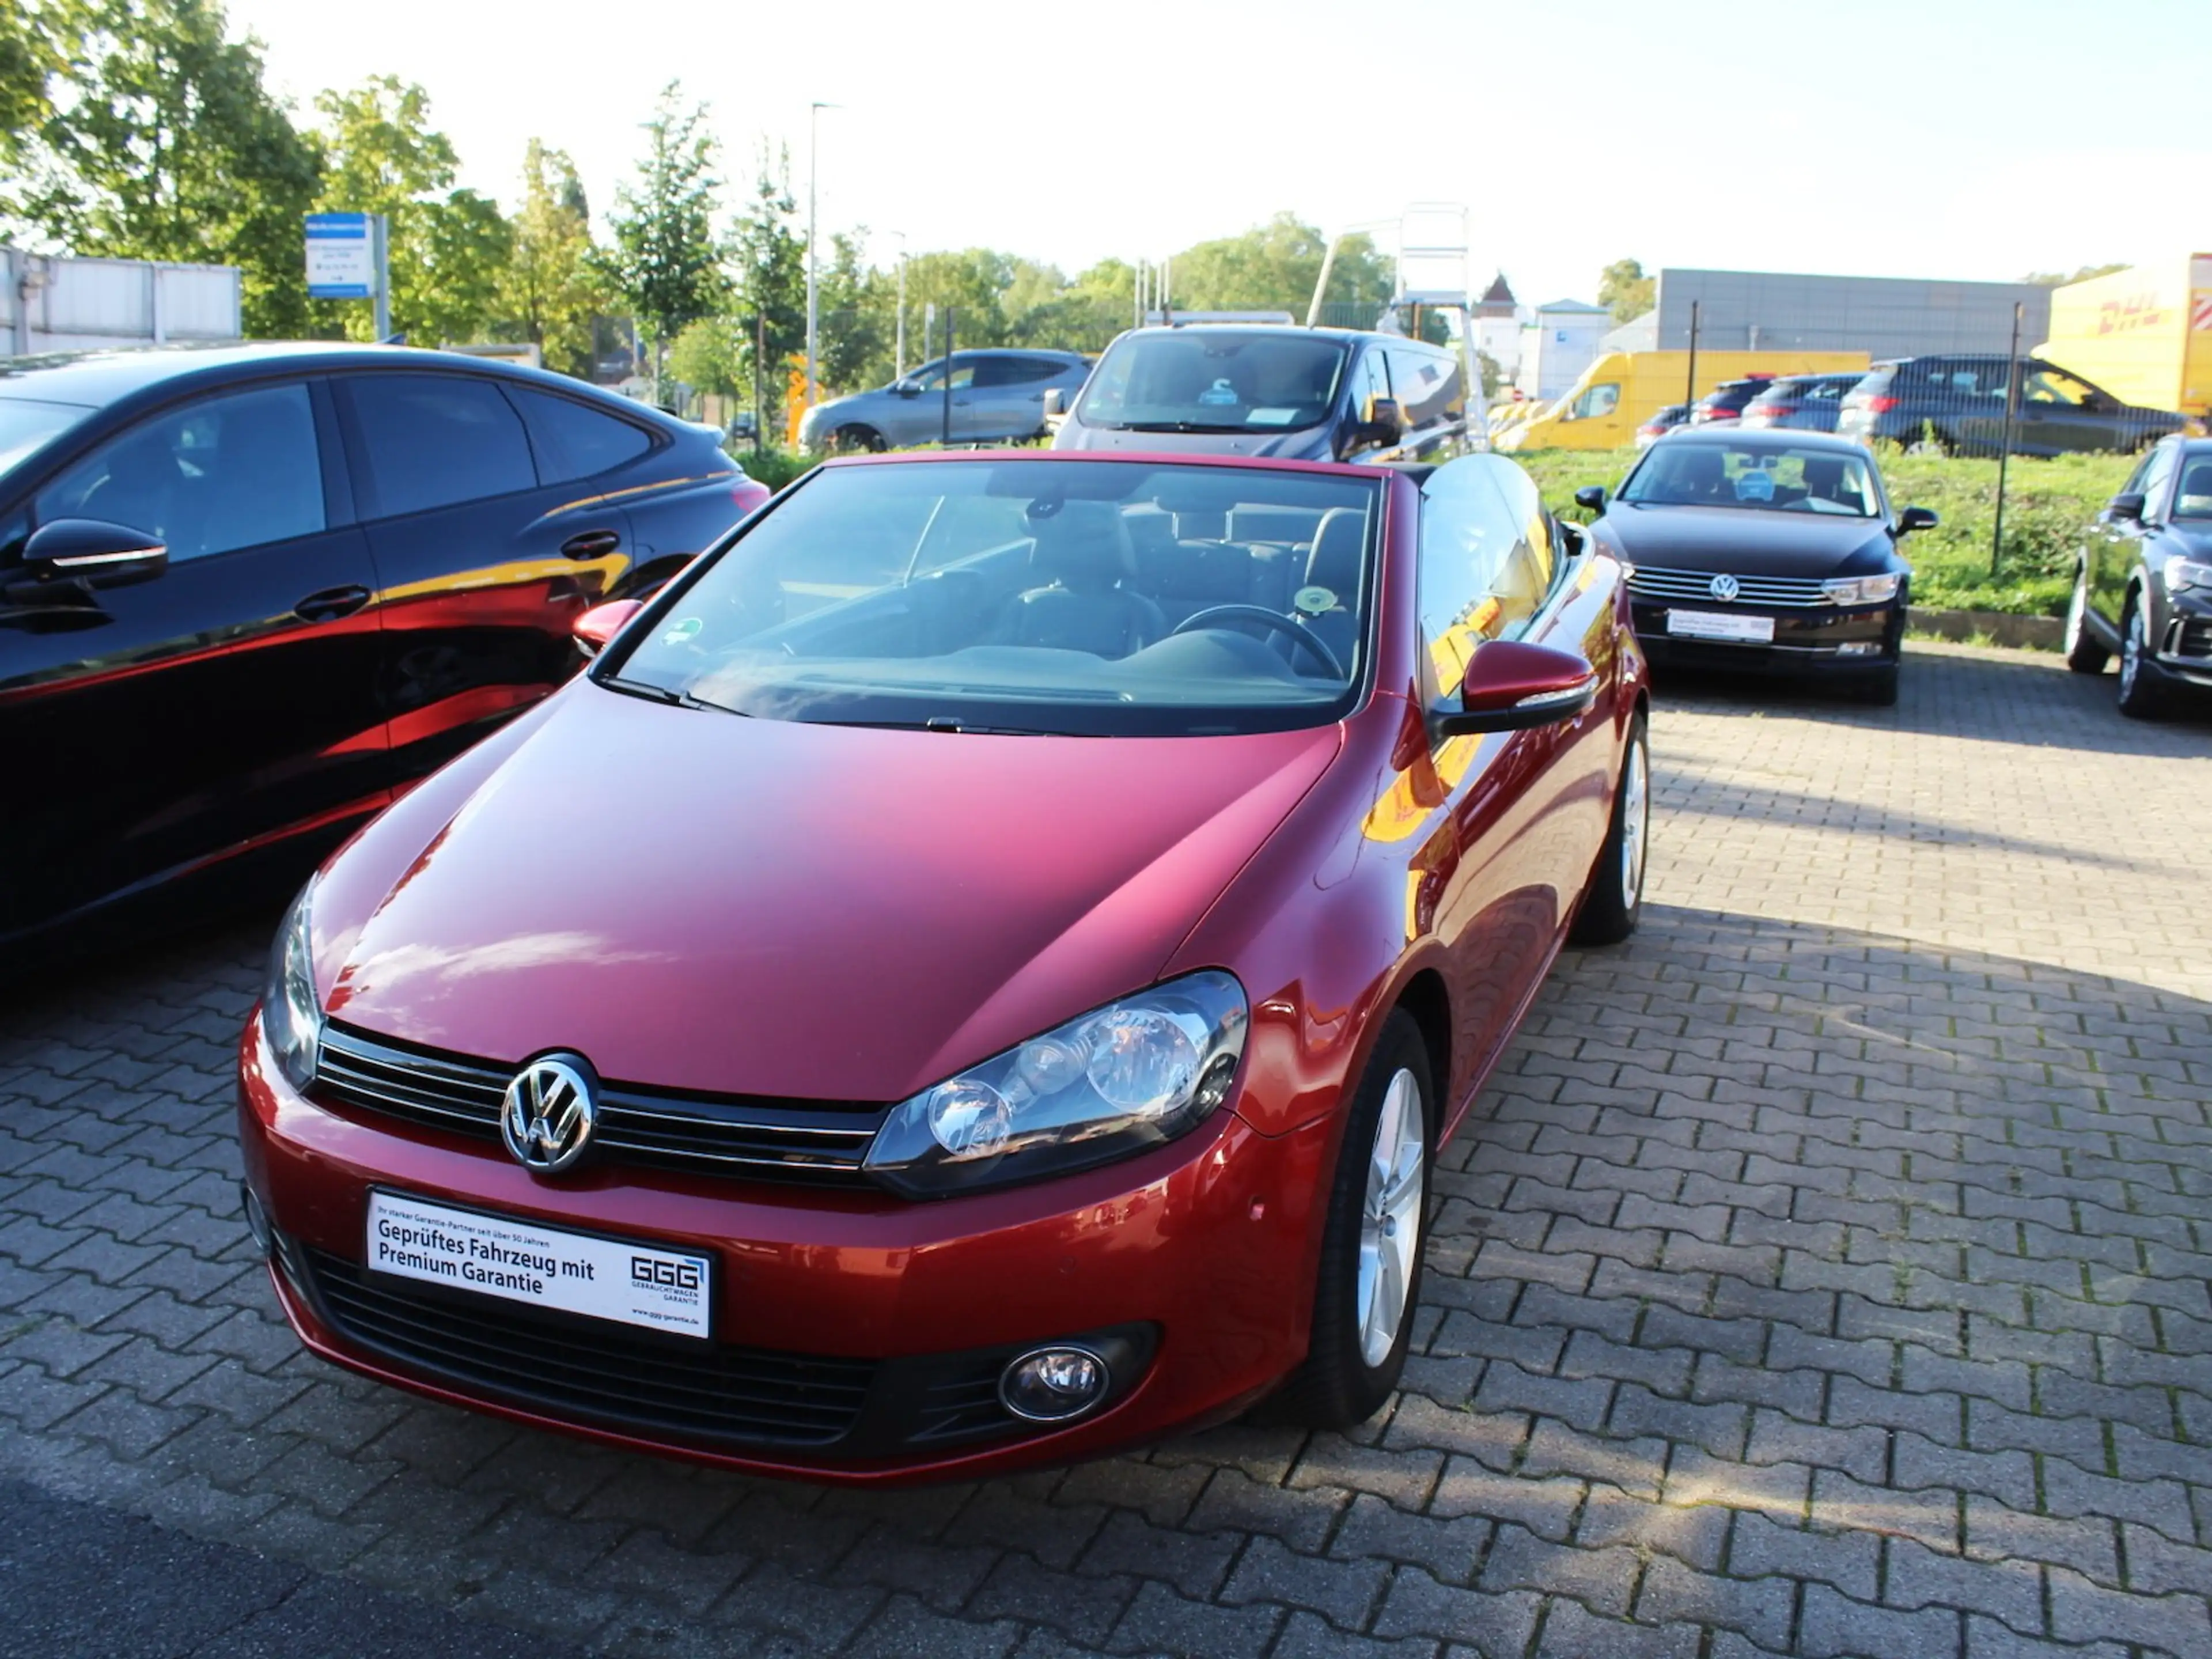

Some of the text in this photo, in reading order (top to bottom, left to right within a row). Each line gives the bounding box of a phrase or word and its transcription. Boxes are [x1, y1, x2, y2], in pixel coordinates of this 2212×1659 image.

[2100, 293, 2160, 335] DHL
[501, 1060, 592, 1172] VW
[389, 1209, 413, 1219] starker
[415, 1214, 475, 1233] Garantie-Partner
[478, 1228, 490, 1237] seit
[493, 1230, 510, 1240] über
[512, 1234, 522, 1243] 50
[524, 1237, 550, 1248] Jahren
[378, 1219, 594, 1281] Geprüftes Fahrzeug mit
[380, 1242, 543, 1294] Premium Garantie
[631, 1256, 698, 1290] GGG
[632, 1280, 698, 1297] GEBRAUCHTWAGEN
[632, 1309, 699, 1325] www.ggg-garantie.de
[664, 1294, 698, 1306] GARANTIE
